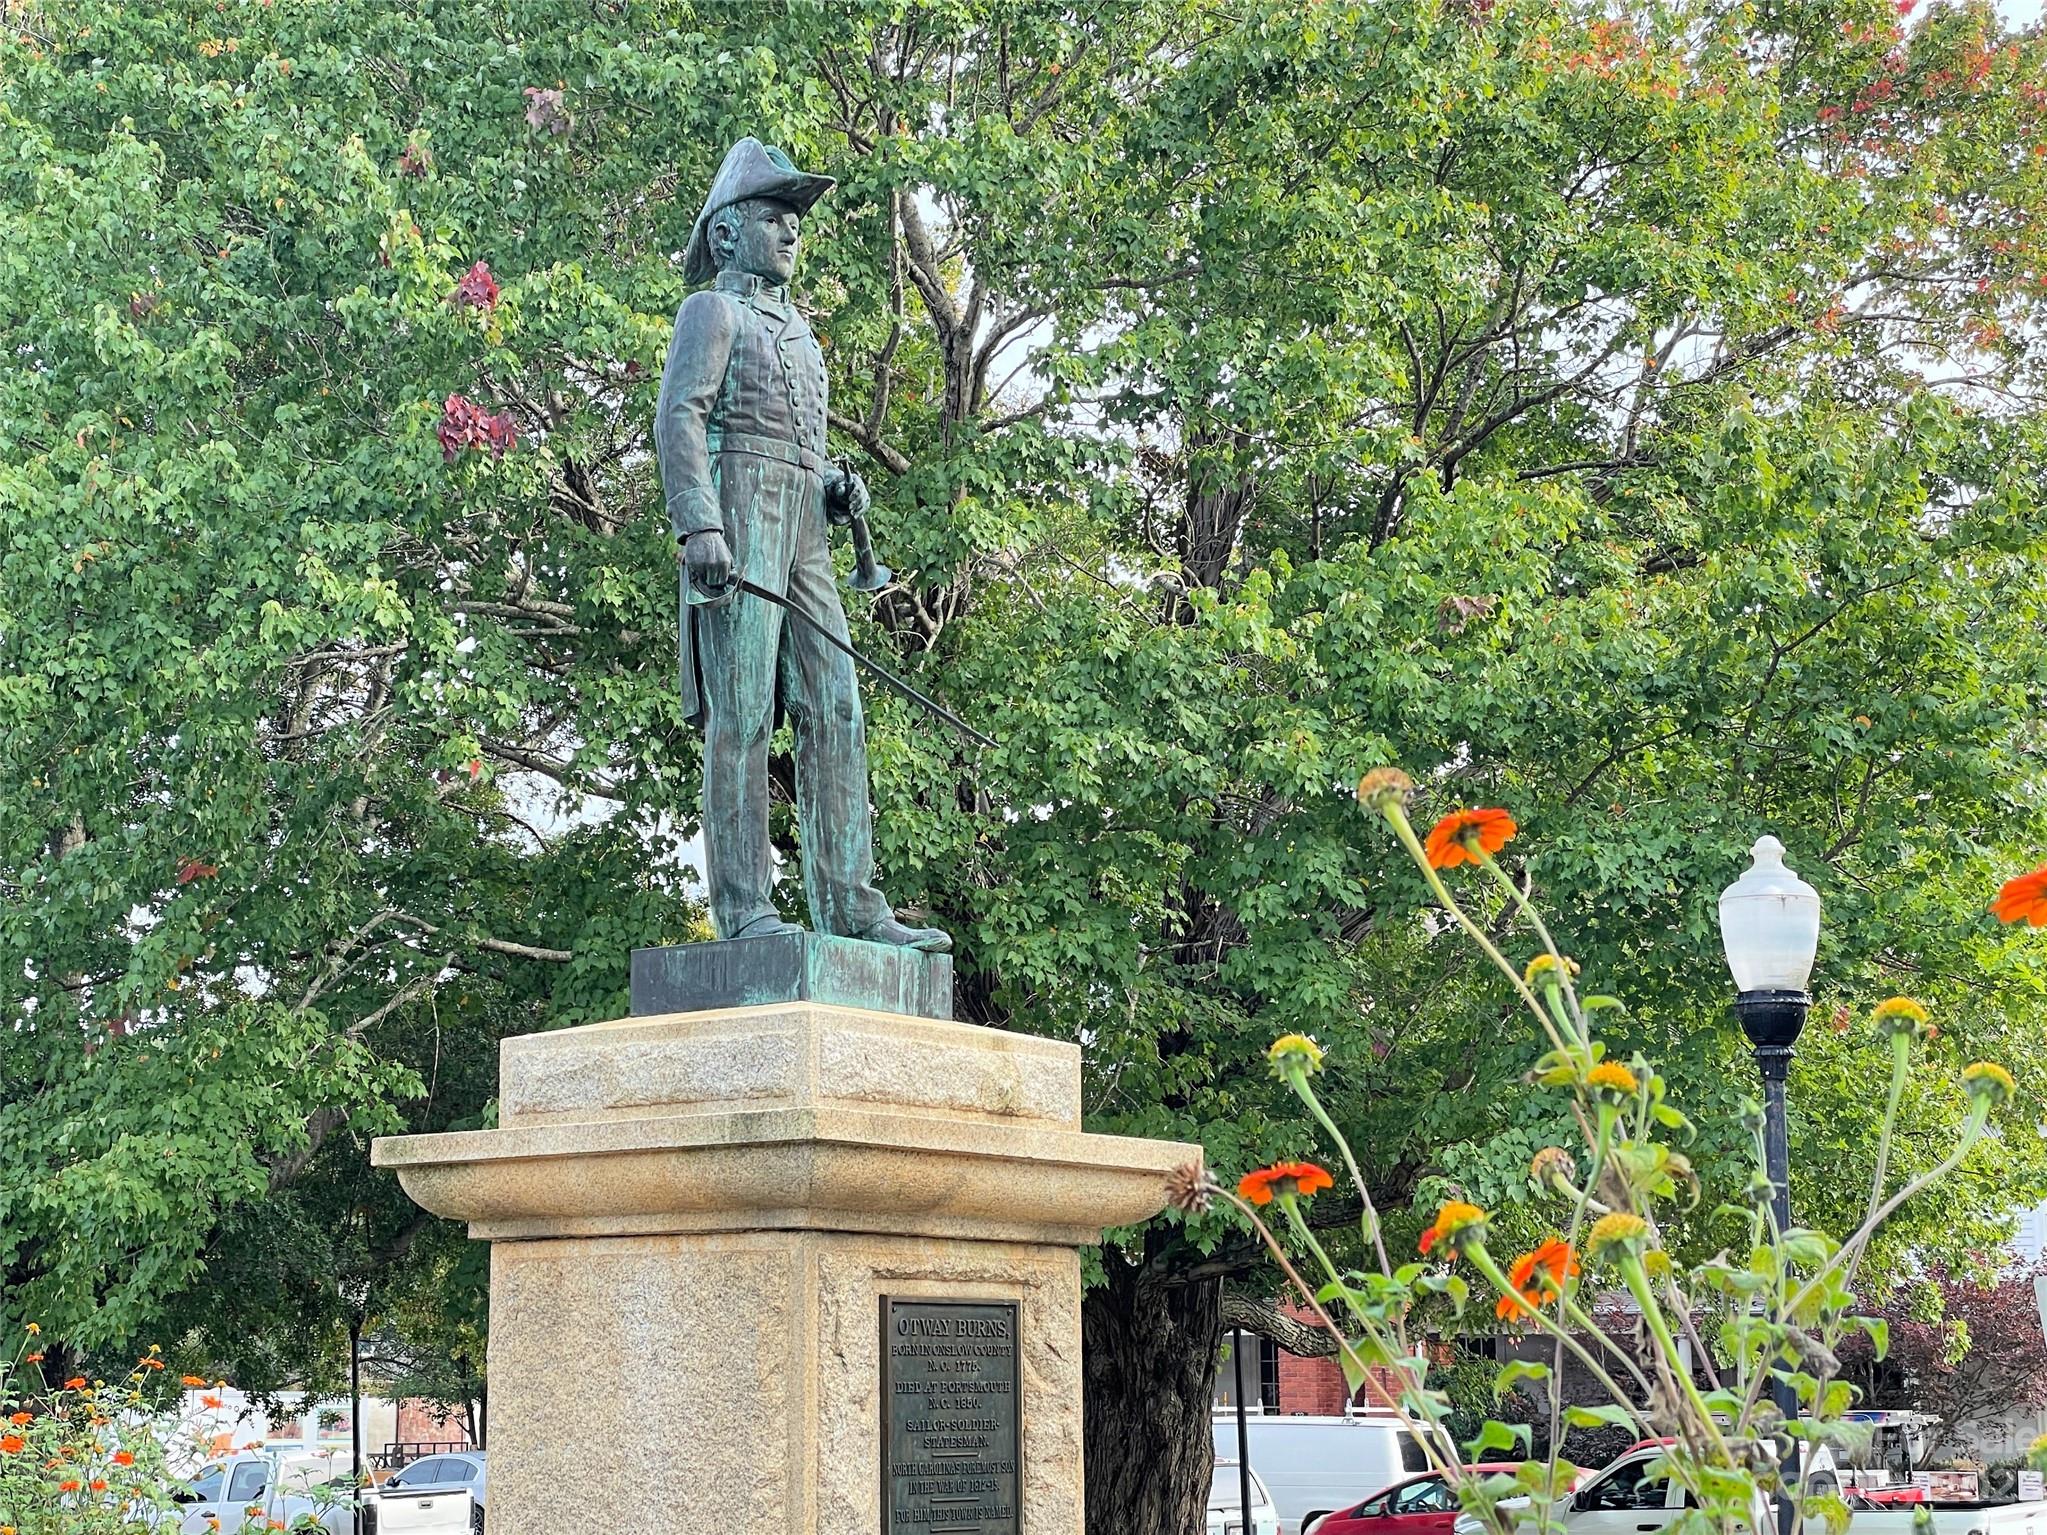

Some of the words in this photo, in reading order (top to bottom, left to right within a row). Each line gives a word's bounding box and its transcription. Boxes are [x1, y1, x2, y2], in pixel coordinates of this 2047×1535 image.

[898, 1318, 951, 1336] OTWAY
[956, 1319, 1011, 1340] BURNS,
[892, 1344, 918, 1356] BORN
[920, 1344, 932, 1356] IN
[932, 1344, 973, 1356] ONSLOW
[974, 1344, 1013, 1357] COUNTY
[895, 1381, 920, 1393] DIED
[923, 1381, 939, 1393] AT
[941, 1381, 1011, 1393] PORTSMOUTH
[924, 1435, 990, 1448] STATESMAN.
[892, 1462, 917, 1476] NORTH
[908, 1481, 919, 1495] IN
[919, 1480, 935, 1494] THE
[956, 1479, 968, 1493] OF
[974, 1506, 984, 1520] IS
